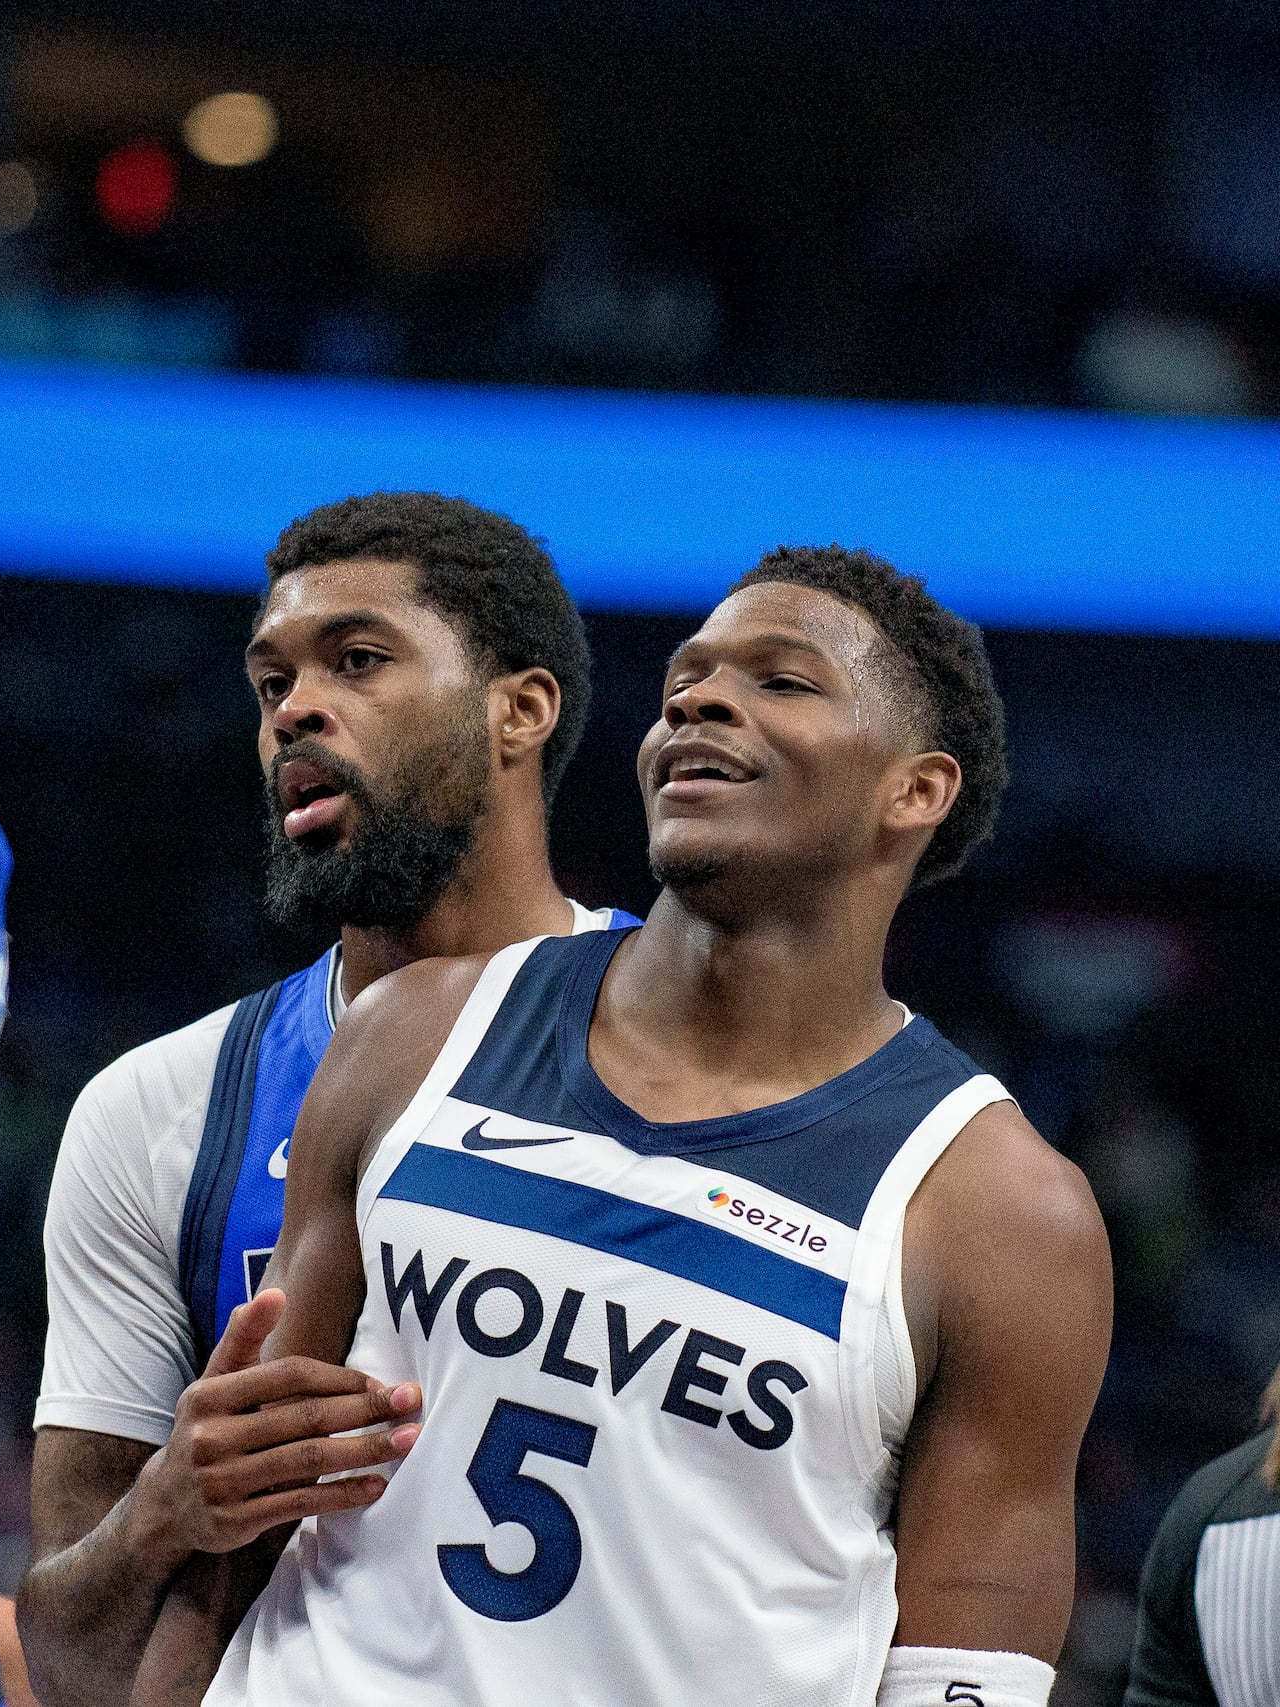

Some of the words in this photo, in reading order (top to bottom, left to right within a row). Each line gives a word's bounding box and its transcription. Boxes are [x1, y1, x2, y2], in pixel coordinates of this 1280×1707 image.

[728, 1198, 828, 1253] sezzle
[380, 1240, 809, 1451] WOLVES
[437, 1397, 599, 1623] 5
